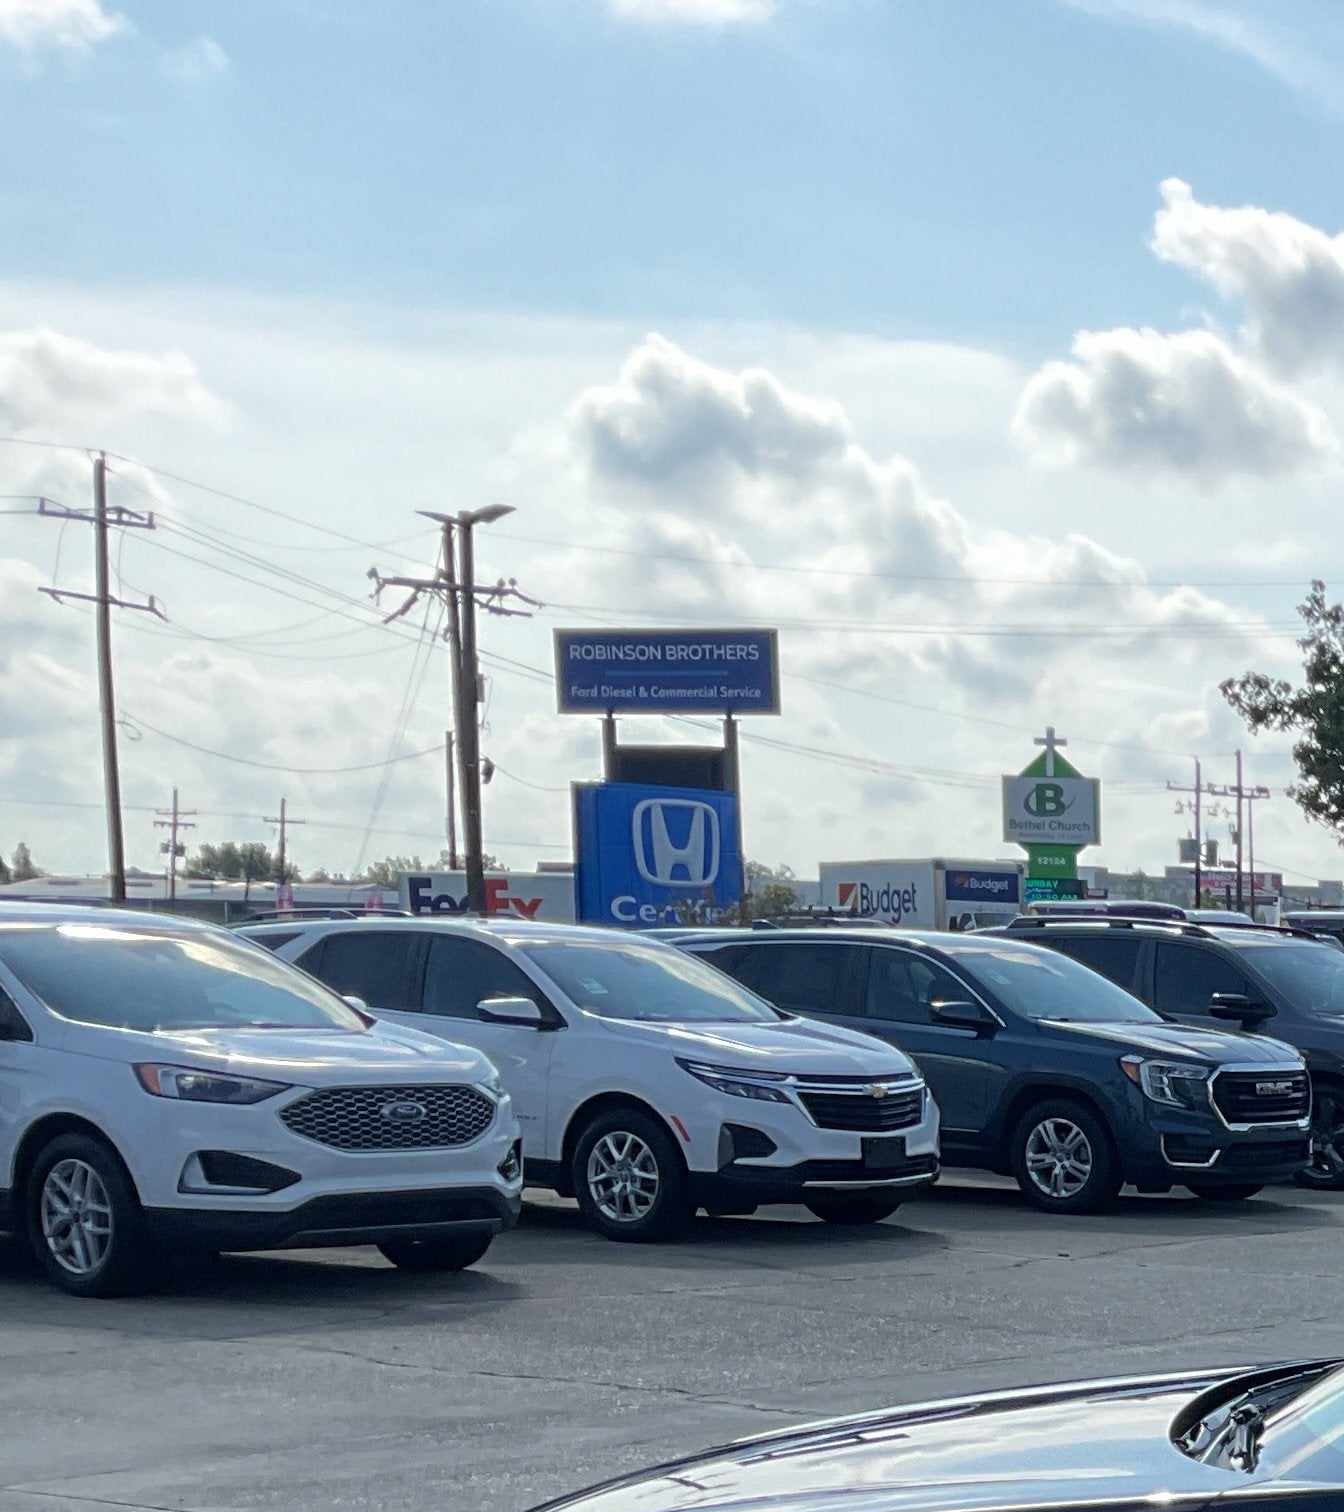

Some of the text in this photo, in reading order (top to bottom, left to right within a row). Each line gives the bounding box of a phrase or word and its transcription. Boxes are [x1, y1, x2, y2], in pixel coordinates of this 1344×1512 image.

[569, 645, 760, 660] ROBINSON BROTHERS
[571, 686, 762, 699] Ford Diesel & Commercial Service
[1036, 783, 1066, 817] B
[1009, 819, 1091, 832] Bethel Church
[969, 877, 1009, 893] Budget
[408, 877, 543, 919] FeEx
[860, 882, 917, 923] Budget
